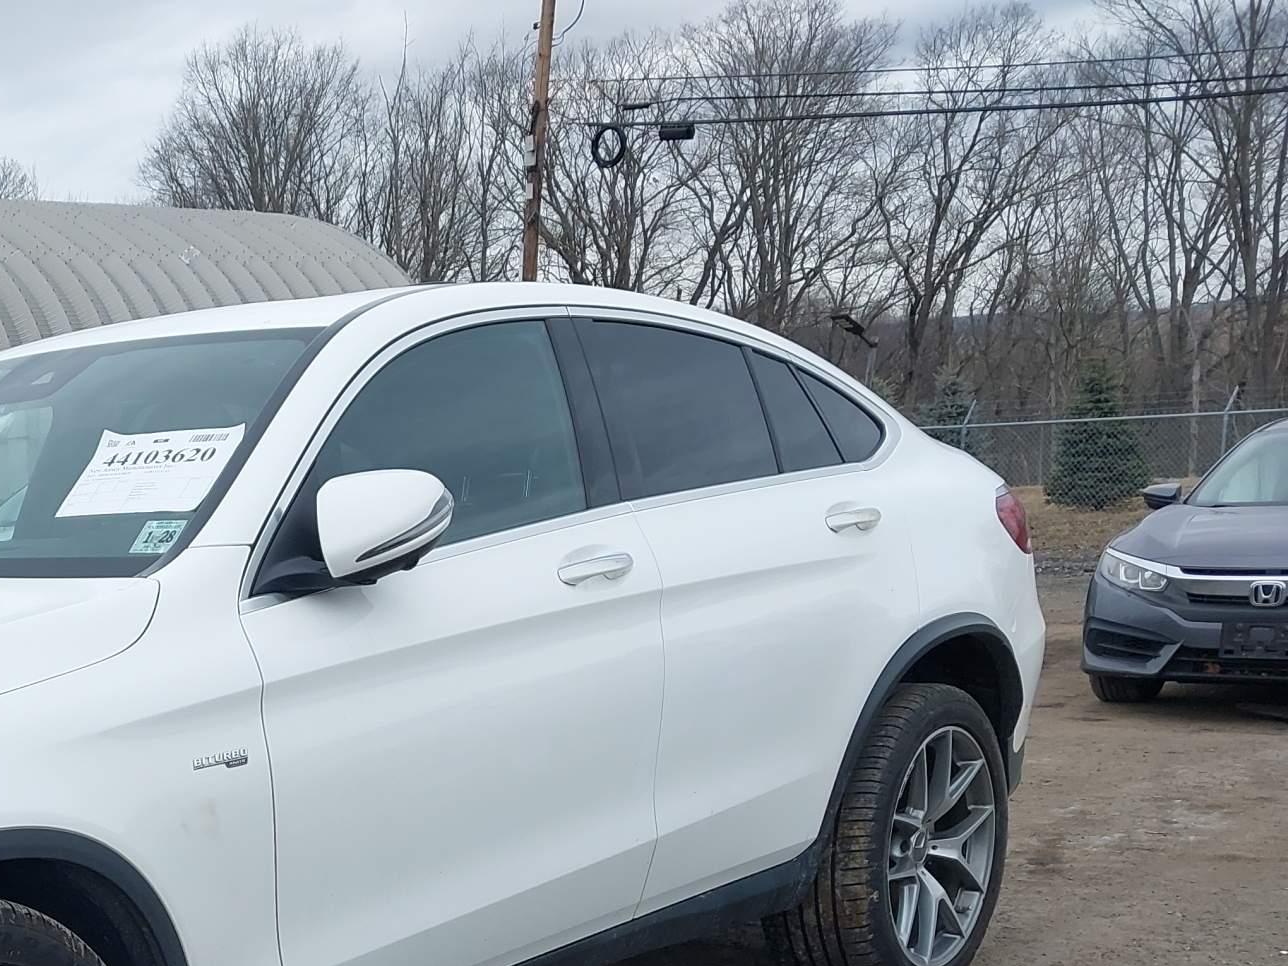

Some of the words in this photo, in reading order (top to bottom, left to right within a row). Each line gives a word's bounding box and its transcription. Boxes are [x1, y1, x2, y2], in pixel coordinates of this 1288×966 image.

[103, 447, 217, 467] 44103620
[158, 529, 177, 543] 28
[193, 748, 249, 769] BITURBO
